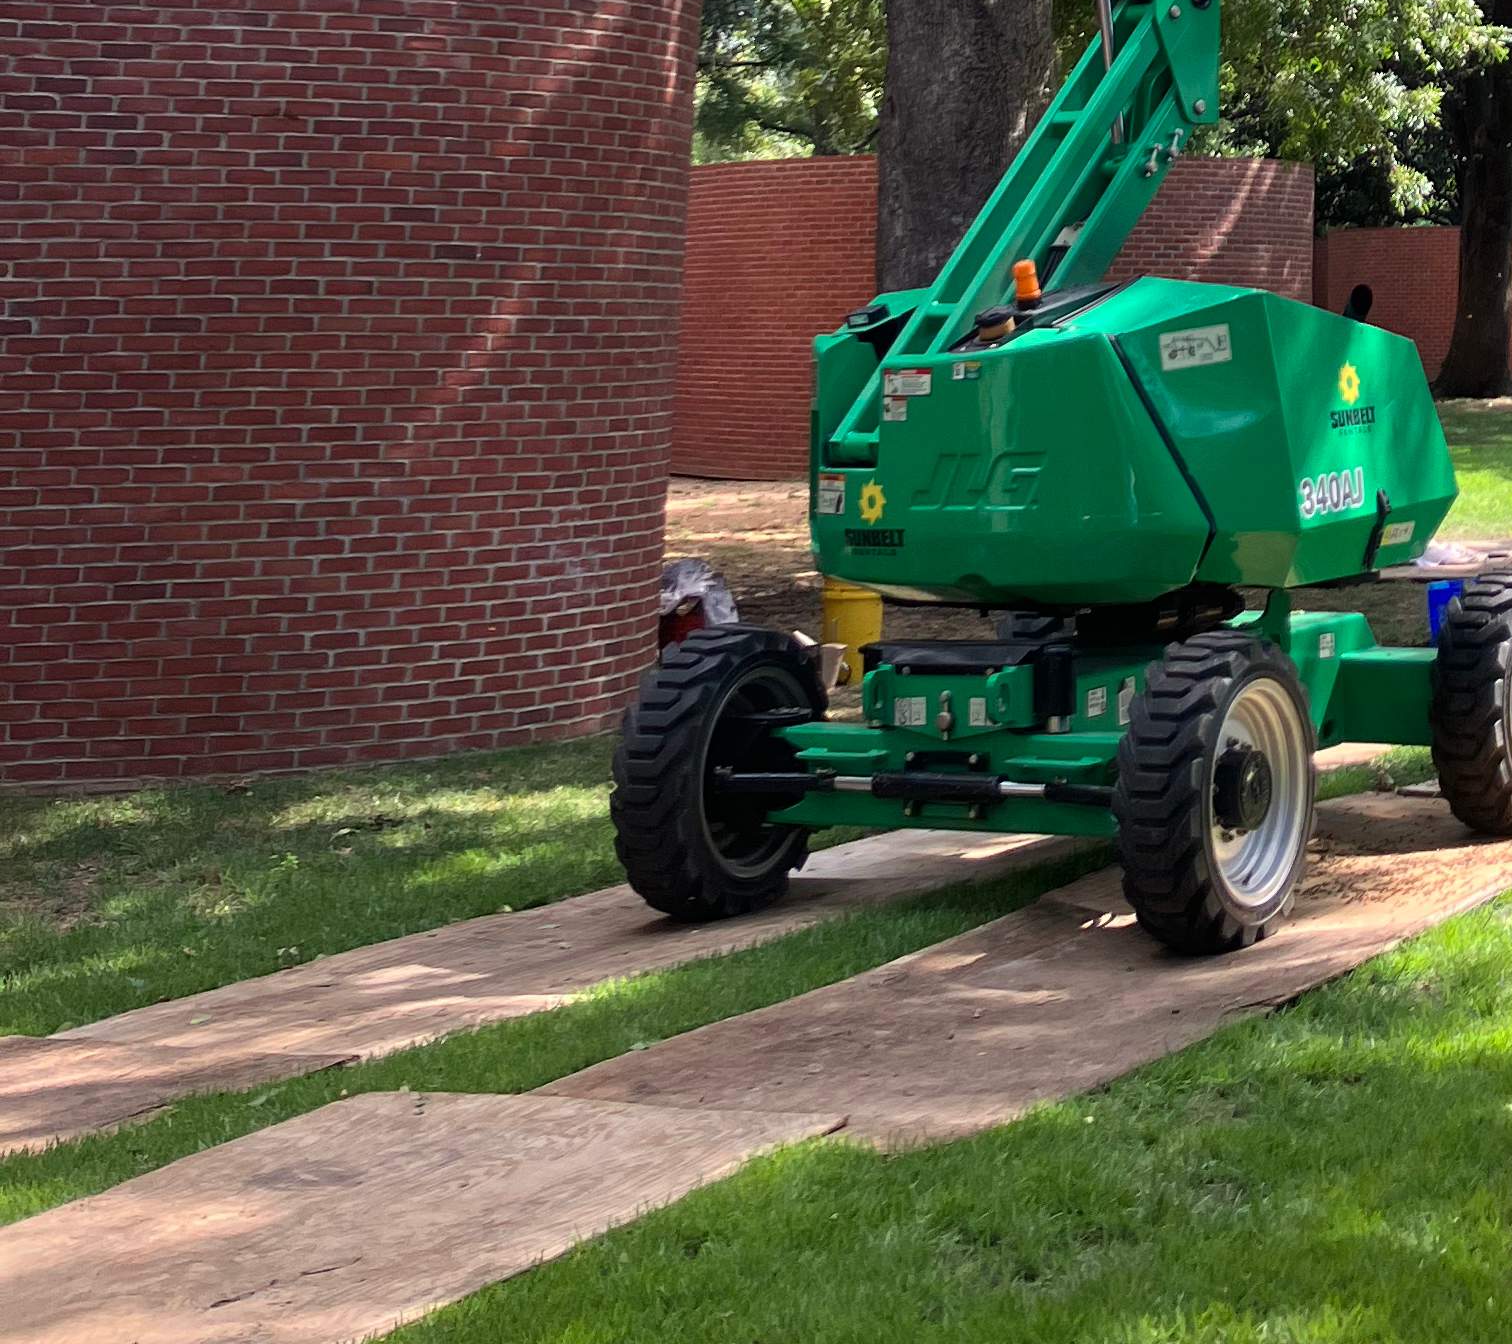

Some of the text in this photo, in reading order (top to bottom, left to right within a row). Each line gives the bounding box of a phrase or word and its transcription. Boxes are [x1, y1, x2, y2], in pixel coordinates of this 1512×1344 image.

[1330, 406, 1375, 429] SUNBELT
[910, 450, 1047, 510] JLG
[1300, 467, 1364, 518] 340AJ
[845, 528, 905, 547] SUNBELT
